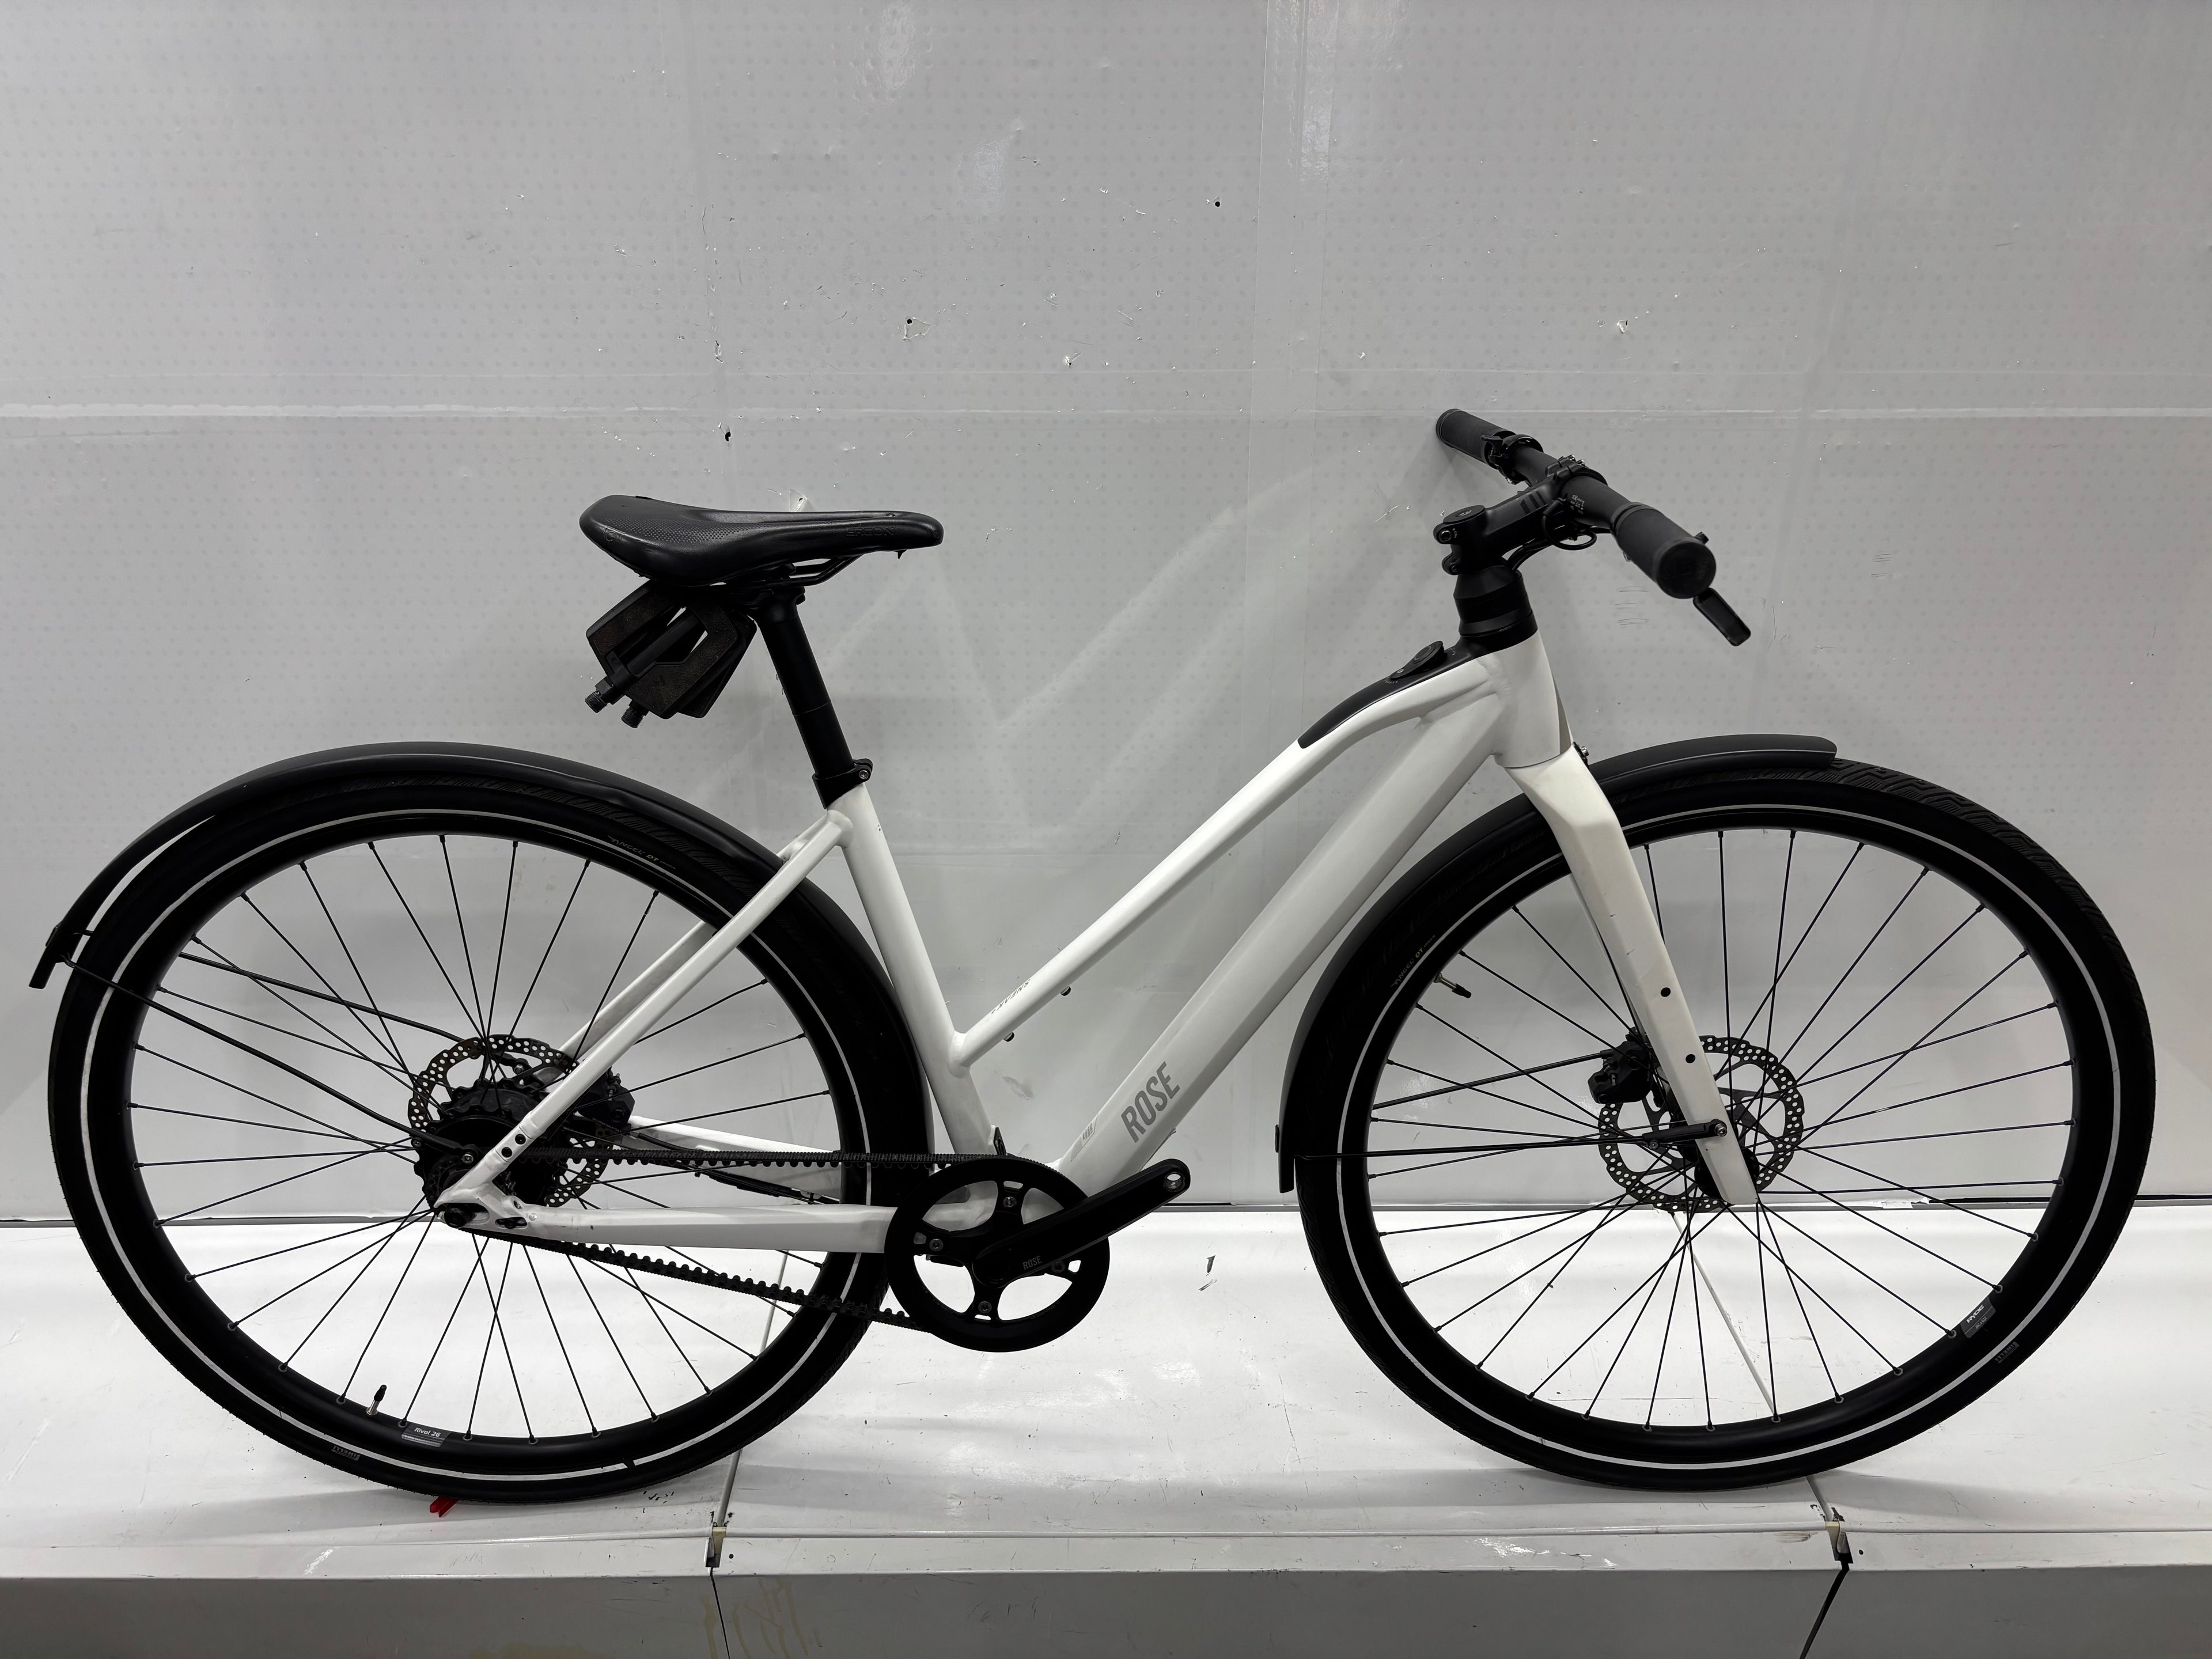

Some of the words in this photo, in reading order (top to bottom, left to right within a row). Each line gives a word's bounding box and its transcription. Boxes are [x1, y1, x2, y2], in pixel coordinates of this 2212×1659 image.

[846, 527, 894, 536] ERGON
[1121, 1061, 1180, 1143] ROSE
[1022, 1255, 1042, 1270] ROSE
[414, 1427, 430, 1435] Rival
